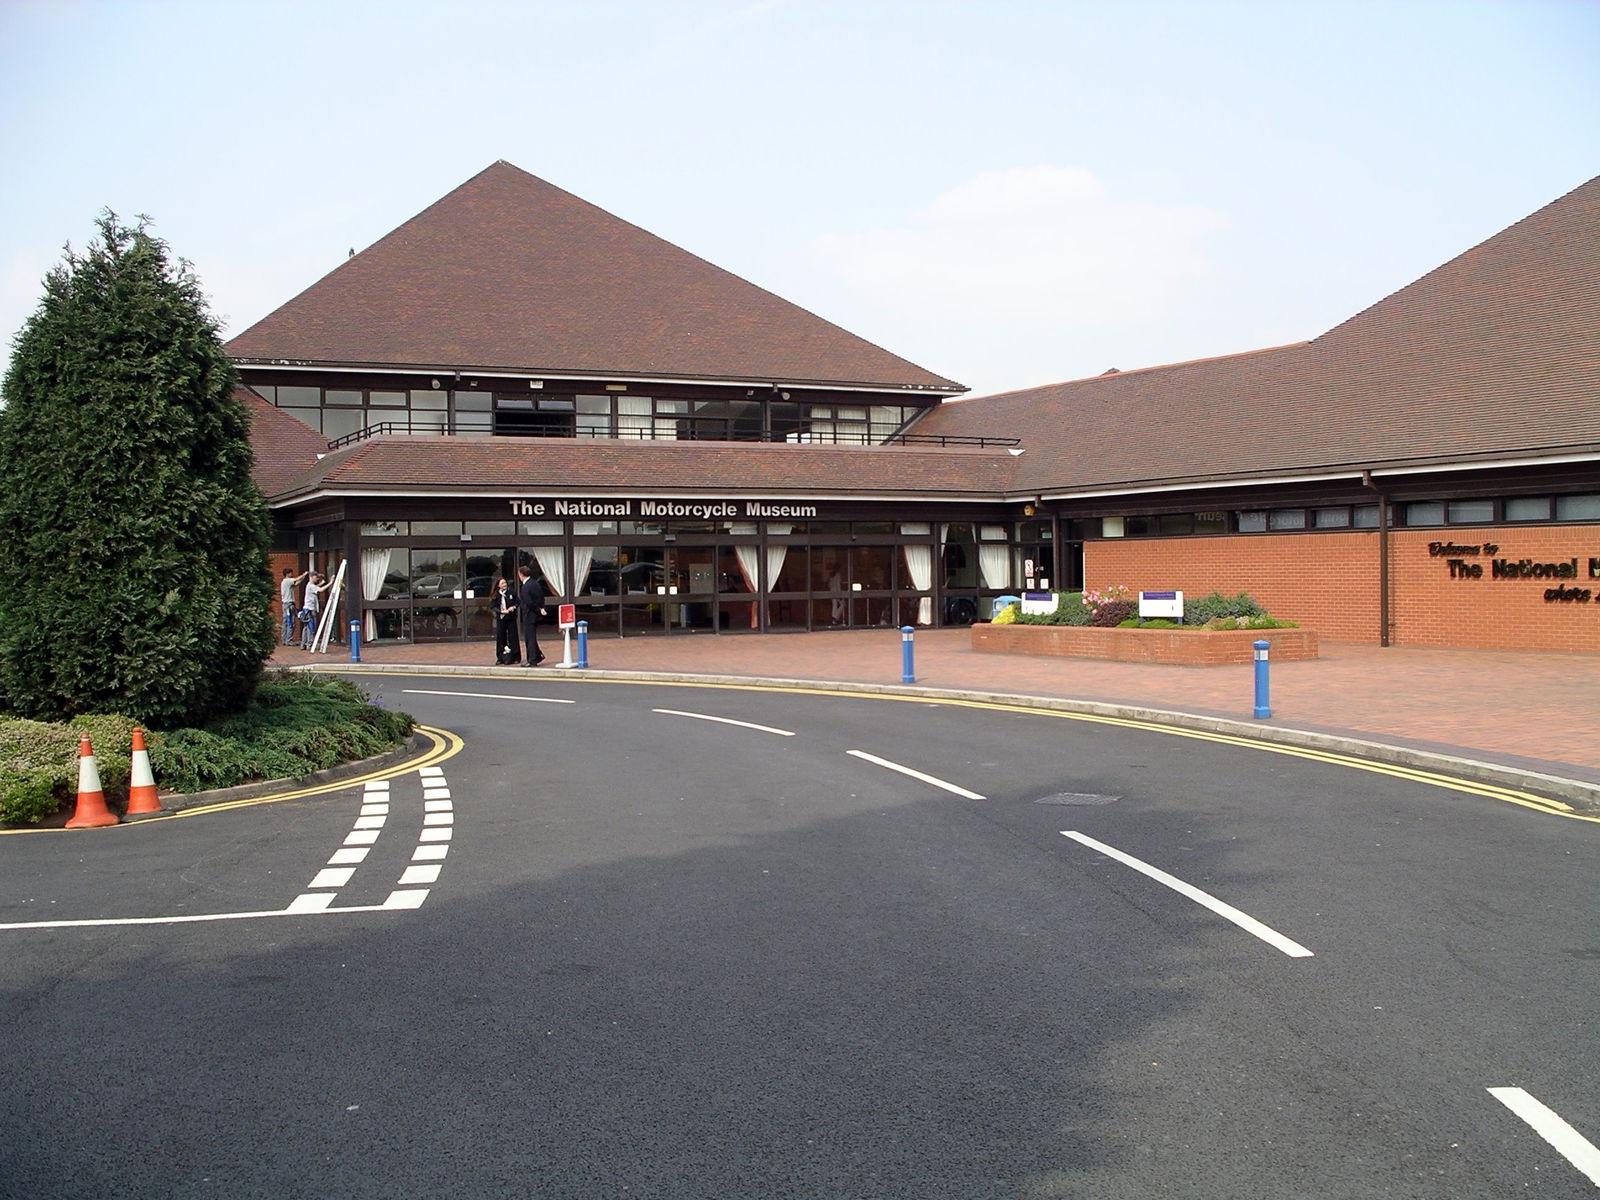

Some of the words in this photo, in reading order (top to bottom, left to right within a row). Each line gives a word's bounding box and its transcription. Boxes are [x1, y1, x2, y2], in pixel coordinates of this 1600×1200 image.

[509, 500, 545, 516] The
[555, 500, 632, 516] National
[641, 501, 737, 519] Motorcycle
[746, 502, 817, 517] Museum
[1447, 559, 1482, 578] The
[1492, 558, 1578, 578] National
